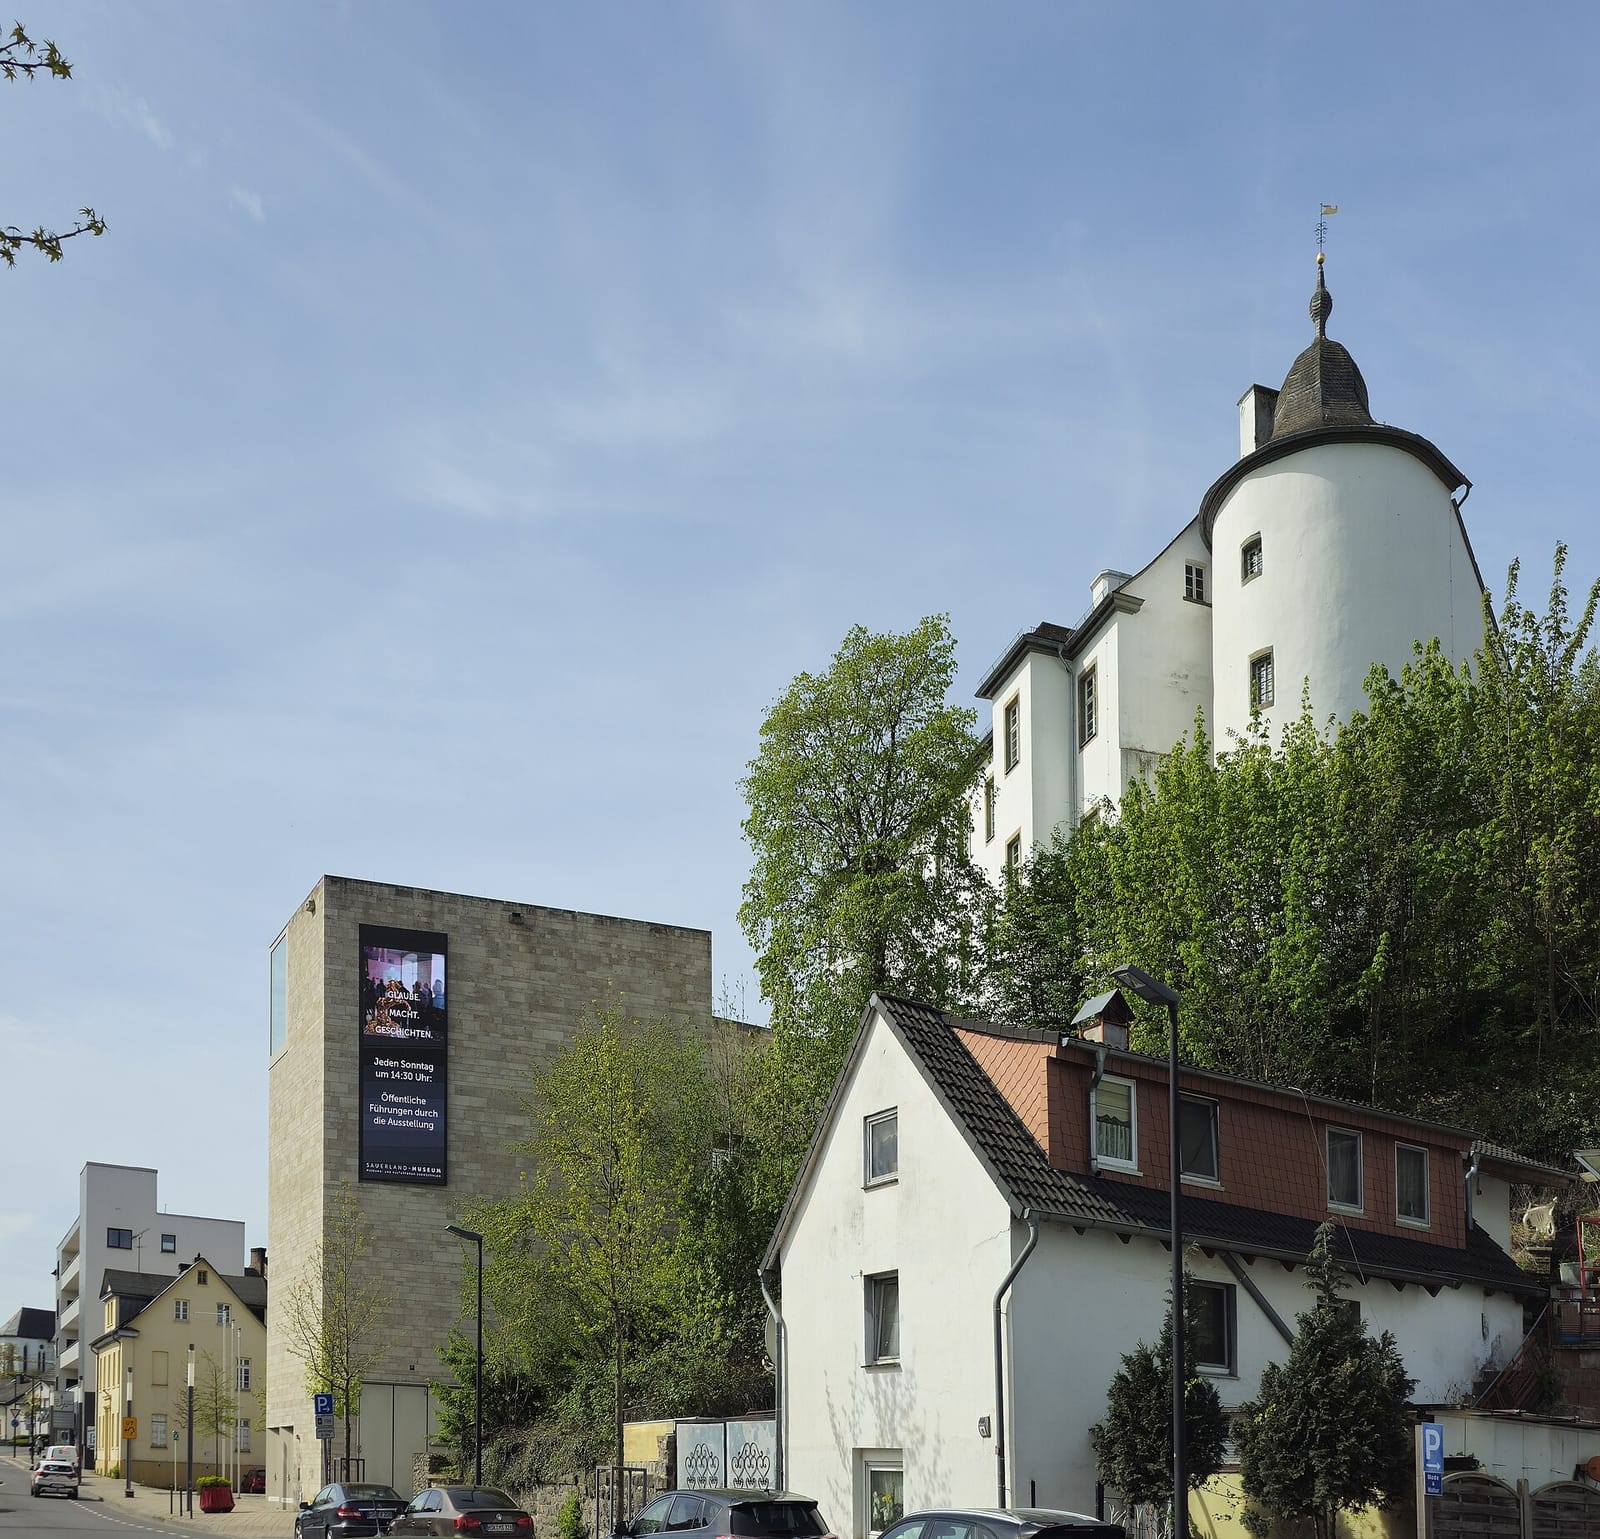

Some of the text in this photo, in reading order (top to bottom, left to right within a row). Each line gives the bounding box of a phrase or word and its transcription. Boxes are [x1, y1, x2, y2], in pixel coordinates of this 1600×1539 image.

[387, 990, 421, 1001] GLAUBE.
[389, 1009, 420, 1019] MACHT.
[375, 1026, 433, 1039] GESCHICHTEN.
[373, 1057, 434, 1072] Jeden Sonntag
[390, 1071, 413, 1080] 14:30
[415, 1073, 433, 1082] Uhr:
[381, 1091, 427, 1105] Öffentliche
[369, 1104, 438, 1118] Führungen durch
[373, 1117, 434, 1131] die Ausstellung
[366, 1162, 442, 1173] SAUERLAND-MUSEUM
[317, 1396, 328, 1412] P
[1425, 1429, 1440, 1460] P
